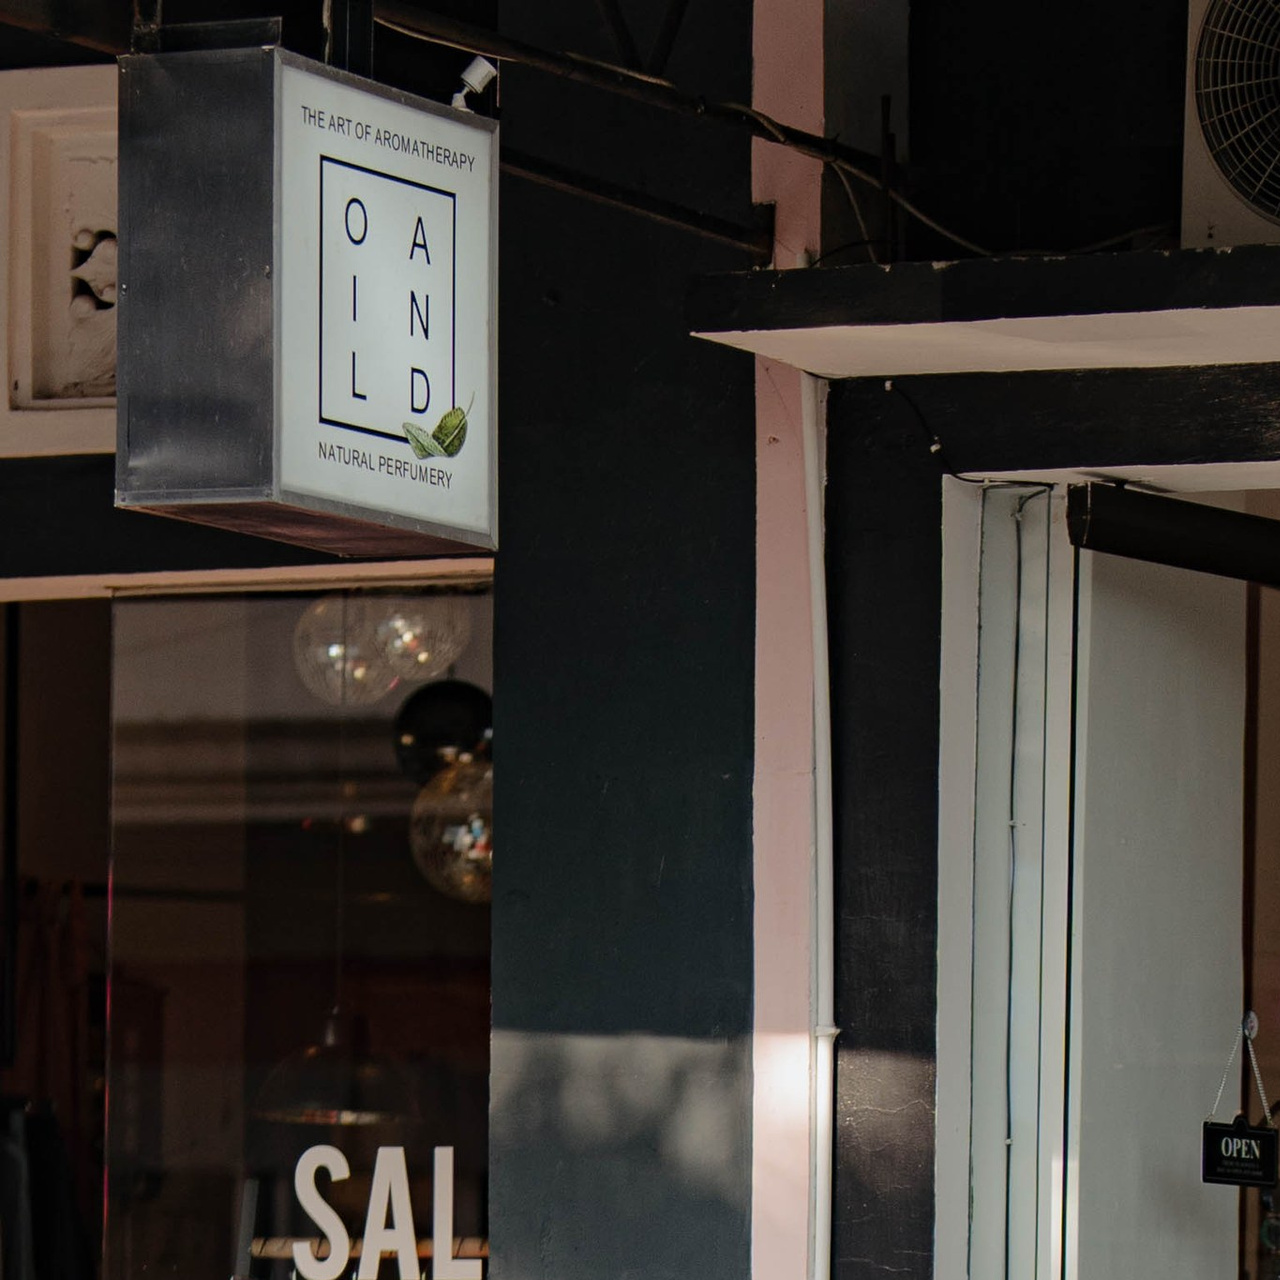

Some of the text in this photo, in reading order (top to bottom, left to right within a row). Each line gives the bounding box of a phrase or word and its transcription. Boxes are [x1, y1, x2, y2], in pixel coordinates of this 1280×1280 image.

[301, 105, 475, 173] THE ART OF AROMATHERAPY
[318, 441, 453, 489] NATURAL PERFUMERY
[1221, 1136, 1261, 1160] OPEN
